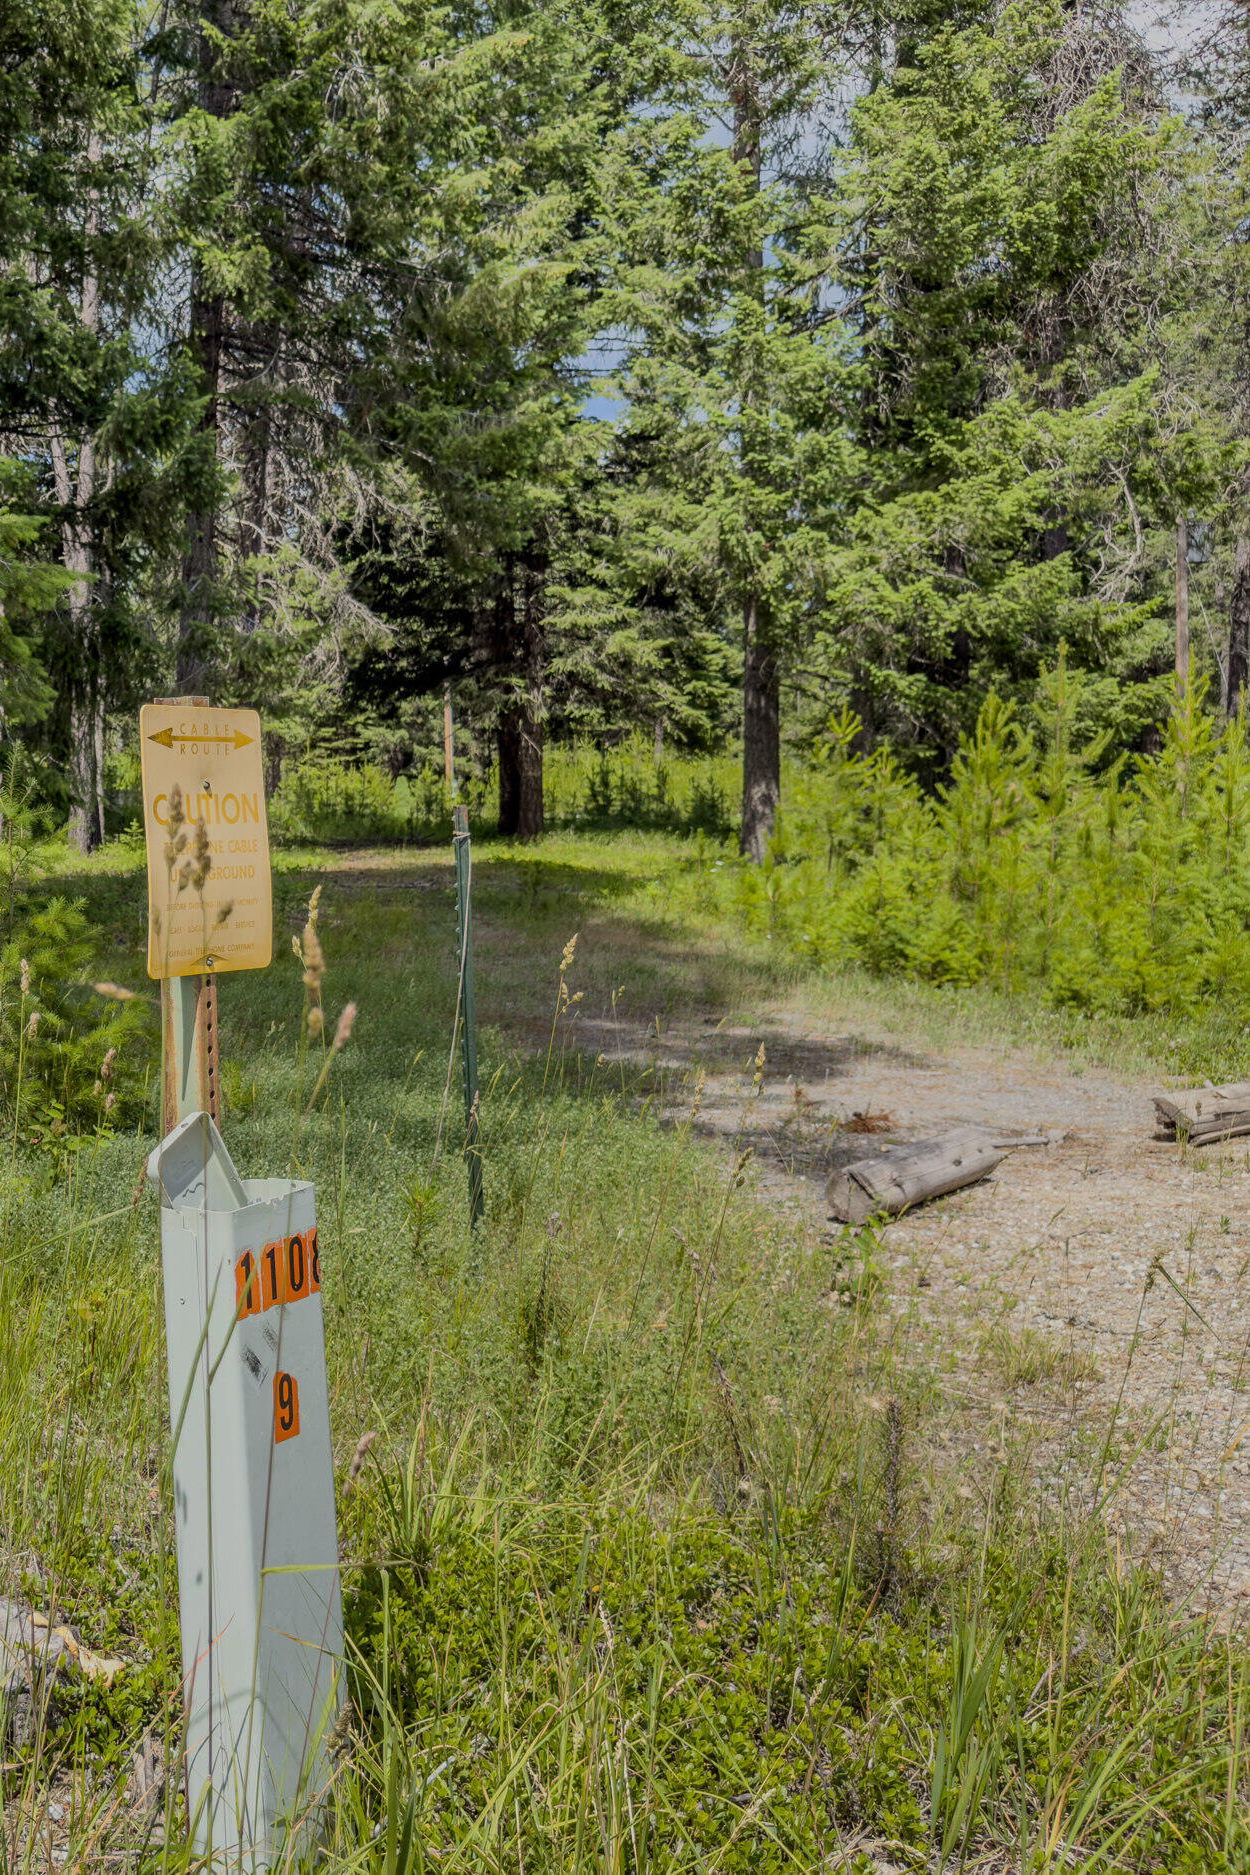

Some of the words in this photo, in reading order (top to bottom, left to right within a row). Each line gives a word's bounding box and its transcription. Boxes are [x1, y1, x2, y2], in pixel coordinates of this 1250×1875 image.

[180, 722, 229, 736] CABLE
[180, 743, 230, 756] ROUTE
[153, 793, 259, 826] CUTION
[228, 838, 258, 853] CABLE
[278, 1373, 293, 1431] 9
